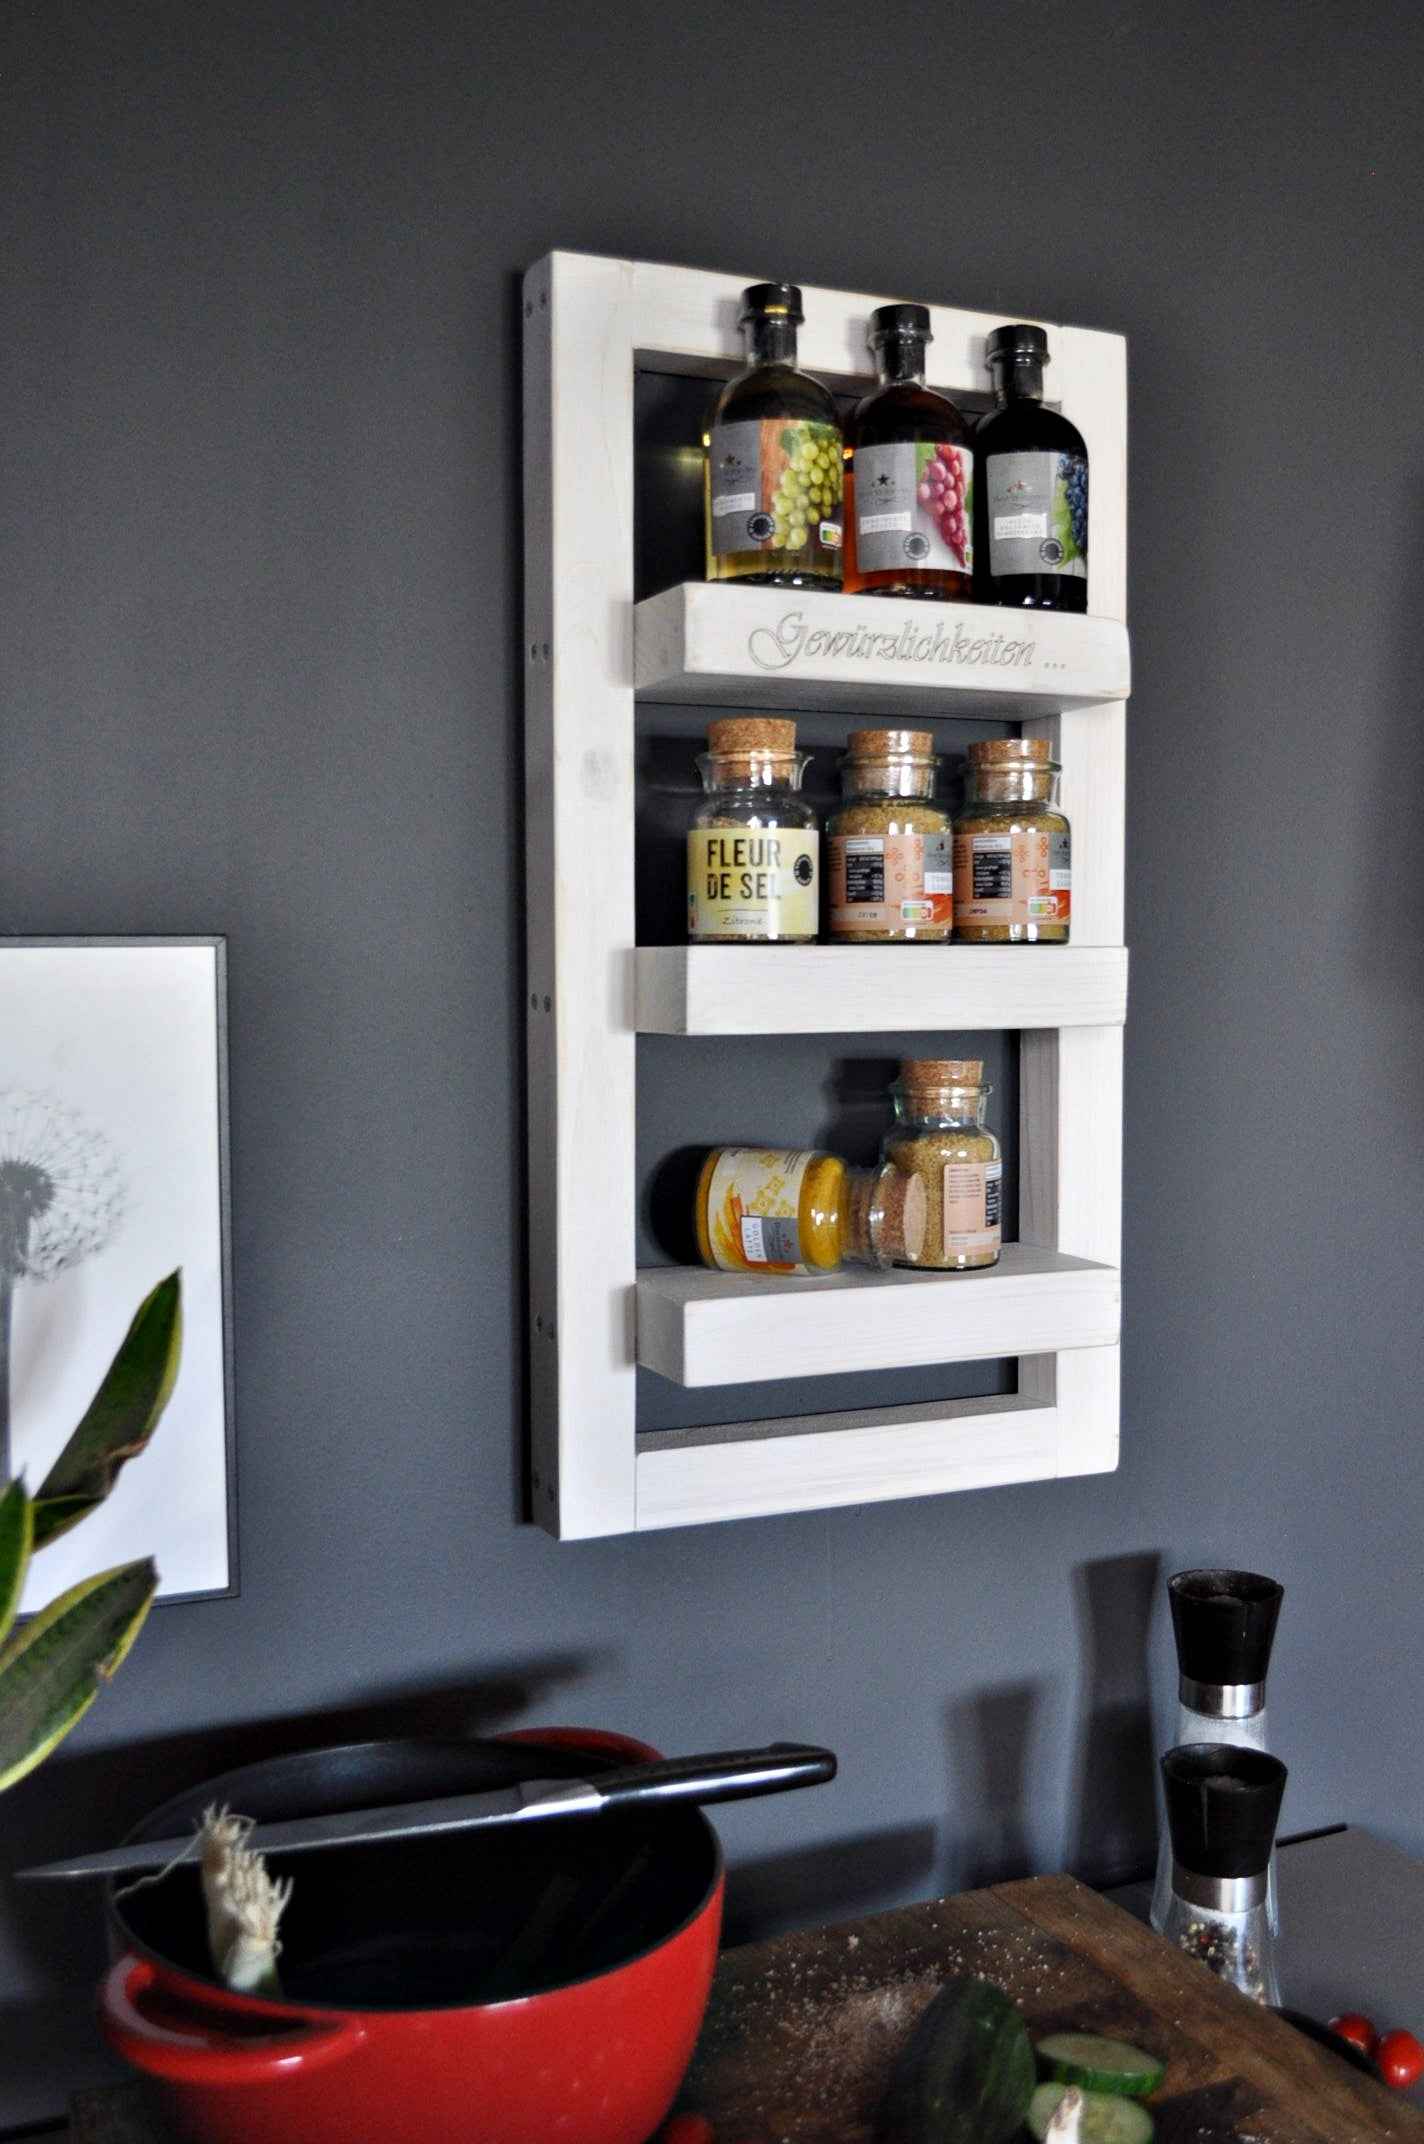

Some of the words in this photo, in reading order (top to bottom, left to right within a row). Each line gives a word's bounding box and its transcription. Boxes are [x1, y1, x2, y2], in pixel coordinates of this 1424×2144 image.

[749, 611, 1036, 670] Gewürzlichkeiten
[707, 838, 781, 868] FLEUR
[706, 872, 732, 900] DE
